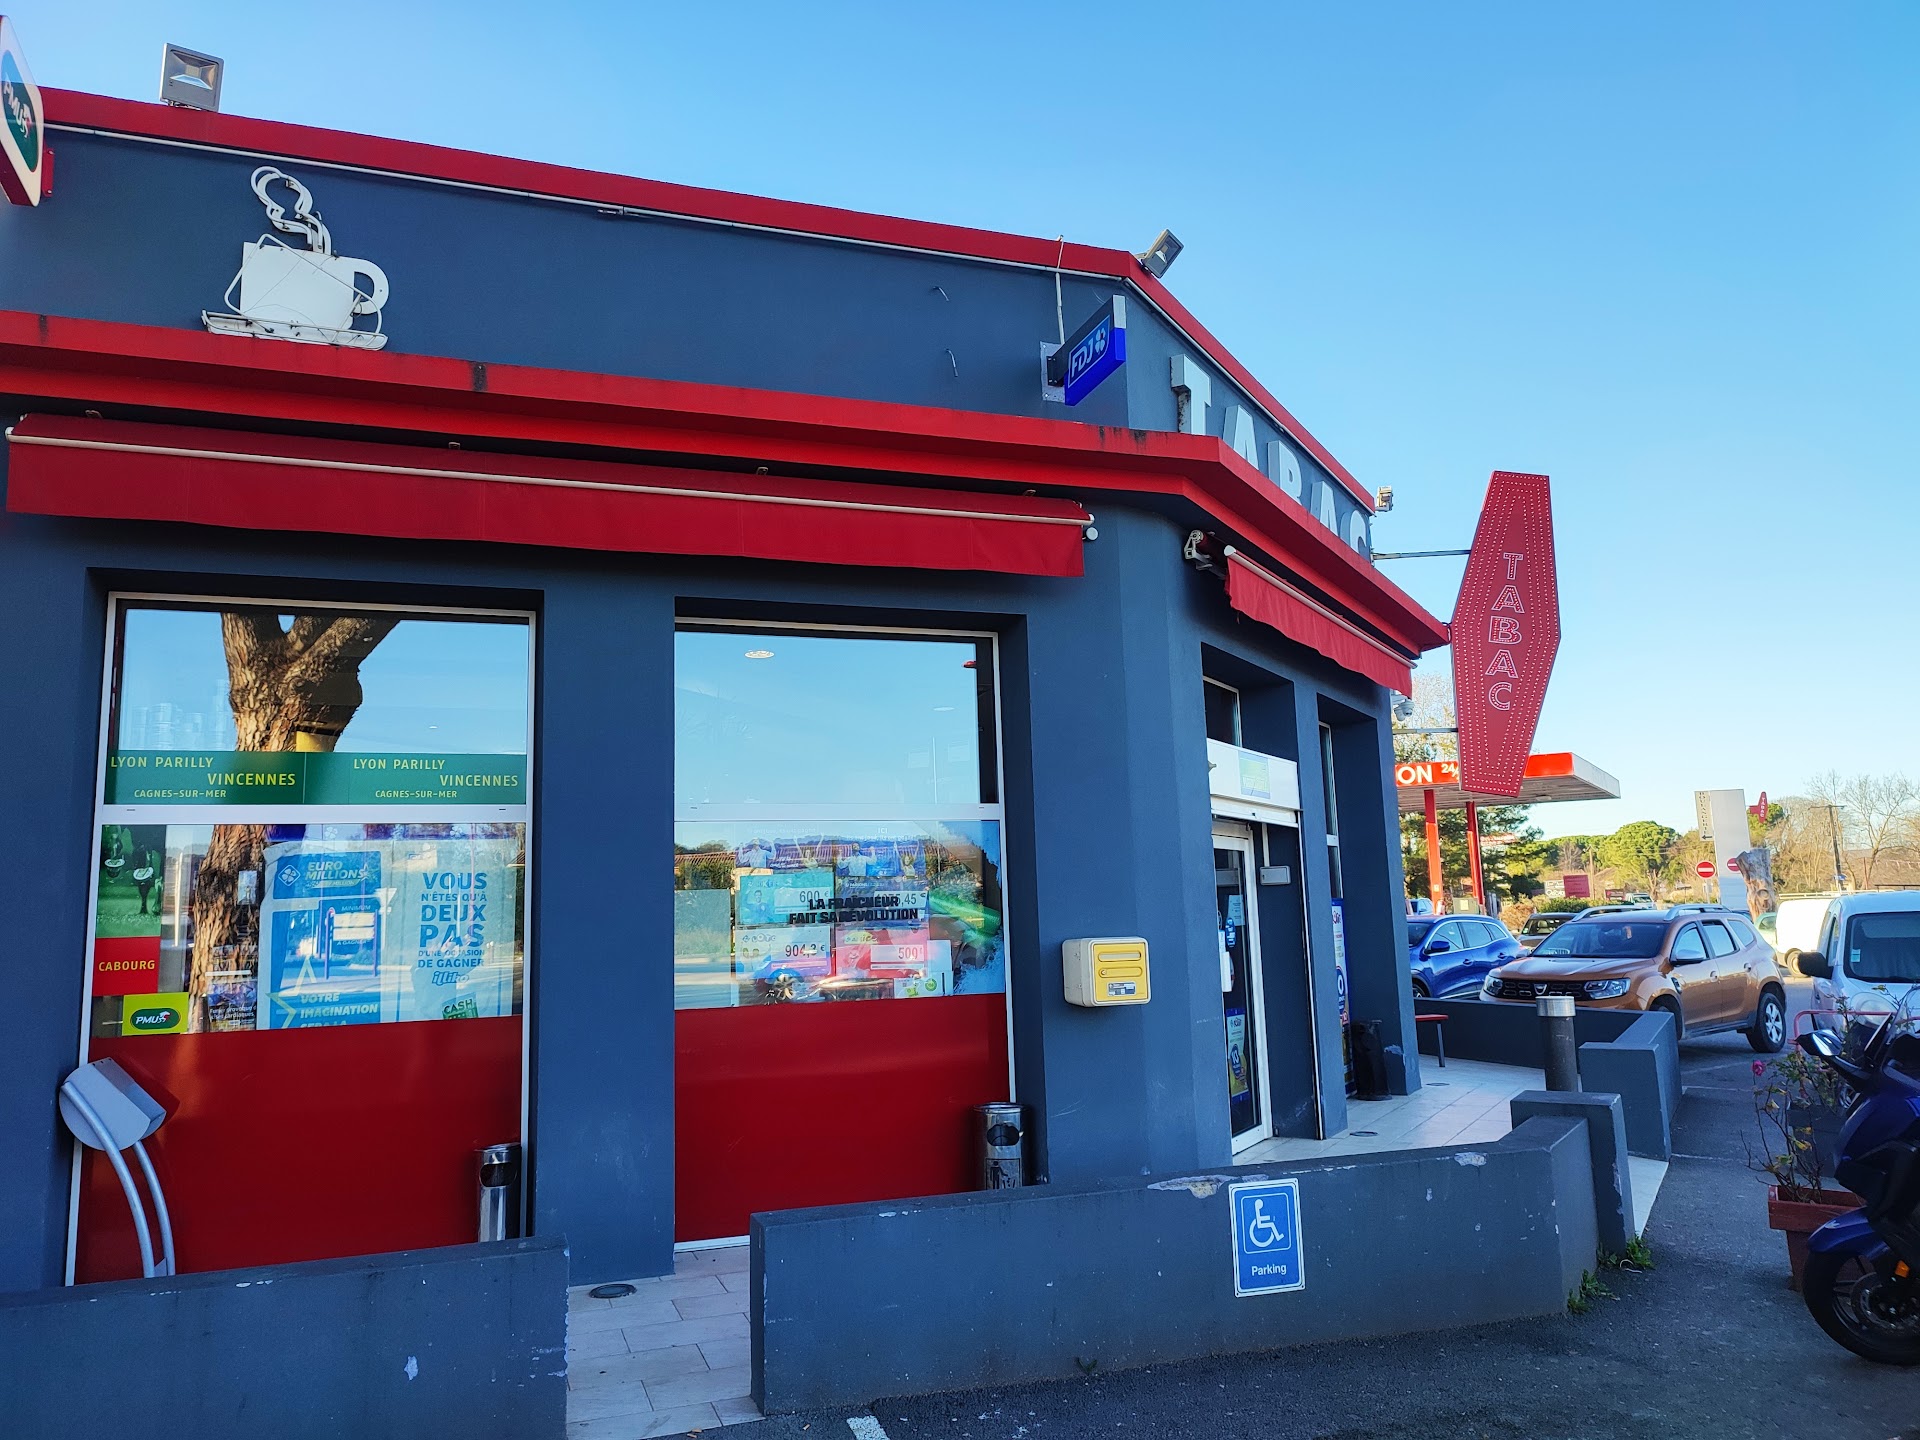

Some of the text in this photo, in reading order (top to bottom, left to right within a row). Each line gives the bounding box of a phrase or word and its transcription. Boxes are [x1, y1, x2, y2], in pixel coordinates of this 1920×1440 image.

[1072, 337, 1093, 377] FDJ
[1485, 552, 1525, 711] TABAC
[111, 756, 214, 768] LYON PARILLY
[354, 758, 446, 770] LYON PARILLY
[1441, 763, 1459, 780] 24/
[207, 773, 296, 786] VINCENNES
[439, 774, 519, 787] VINCENNES
[134, 789, 227, 798] CAGNES-SUR-MER
[375, 790, 457, 798] CAGNES-SUR-MER
[308, 861, 343, 871] EURO
[305, 869, 365, 880] MILLIONS
[423, 873, 487, 890] VOUS
[421, 890, 487, 903] N'ÊTES QU'À
[800, 890, 820, 903] 600
[808, 898, 826, 910] LA
[421, 904, 486, 922] DEUX
[789, 912, 817, 924] FAIT
[420, 923, 485, 947] PAS
[898, 947, 918, 960] 500
[98, 960, 155, 971] CABOURG
[418, 959, 485, 968] DE GAGNER
[301, 991, 341, 1004] VOTRE
[300, 1003, 379, 1018] IMAGINATION
[444, 999, 473, 1014] CASH
[135, 1015, 161, 1025] PMU
[1251, 1264, 1287, 1277] Parking
